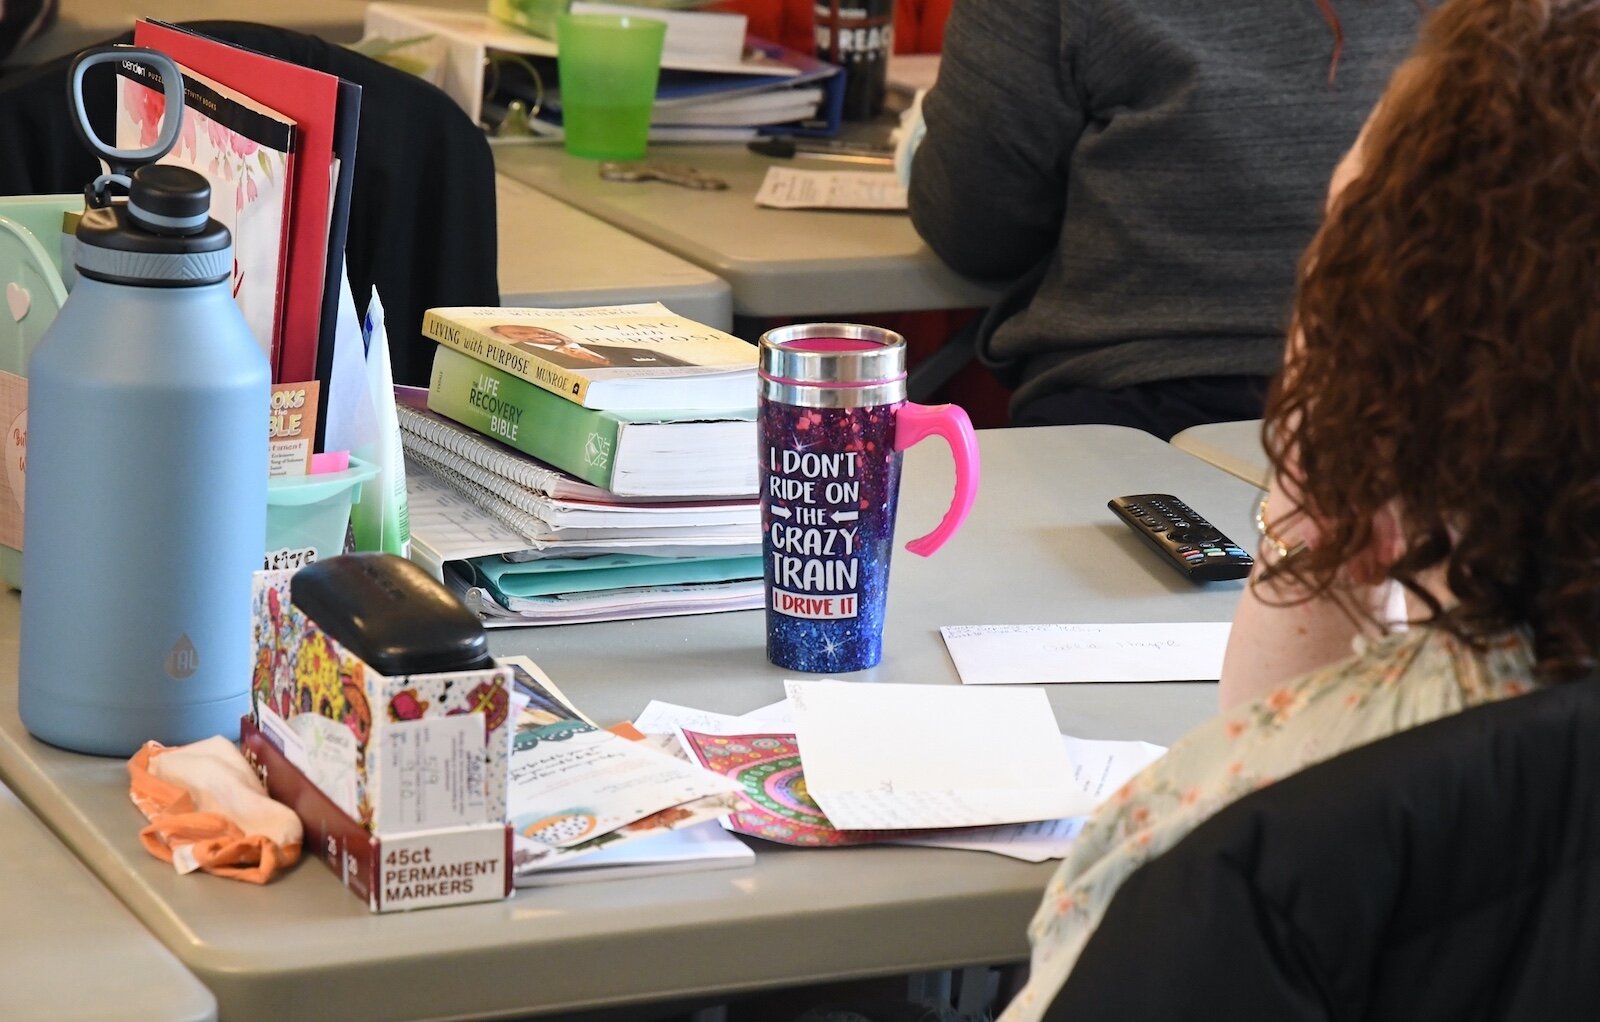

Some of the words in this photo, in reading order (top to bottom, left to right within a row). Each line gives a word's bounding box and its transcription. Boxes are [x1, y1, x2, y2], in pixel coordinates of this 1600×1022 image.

[184, 88, 202, 102] CTIVITY
[202, 97, 217, 111] BOOKS
[429, 319, 460, 345] LIVING
[463, 336, 483, 355] with
[486, 344, 530, 375] PURPOSE
[536, 366, 569, 391] MUNROE
[478, 374, 500, 397] LIFE
[271, 389, 306, 410] OKS
[469, 388, 523, 424] RECOVERY
[269, 414, 303, 438] BLE
[490, 415, 519, 442] BIBLE
[770, 446, 776, 472] I
[782, 450, 858, 478] DON'T
[770, 475, 816, 504] RIDE
[825, 480, 860, 504] ON
[794, 506, 828, 526] THE
[771, 522, 859, 556] CRAZY
[771, 551, 859, 592] TRAIN
[774, 592, 779, 608] I
[782, 594, 834, 616] DRIVE
[840, 597, 854, 615] IT
[385, 847, 431, 866] 45ct
[385, 859, 498, 884] PERMANENT
[386, 878, 474, 902] MARKERS
